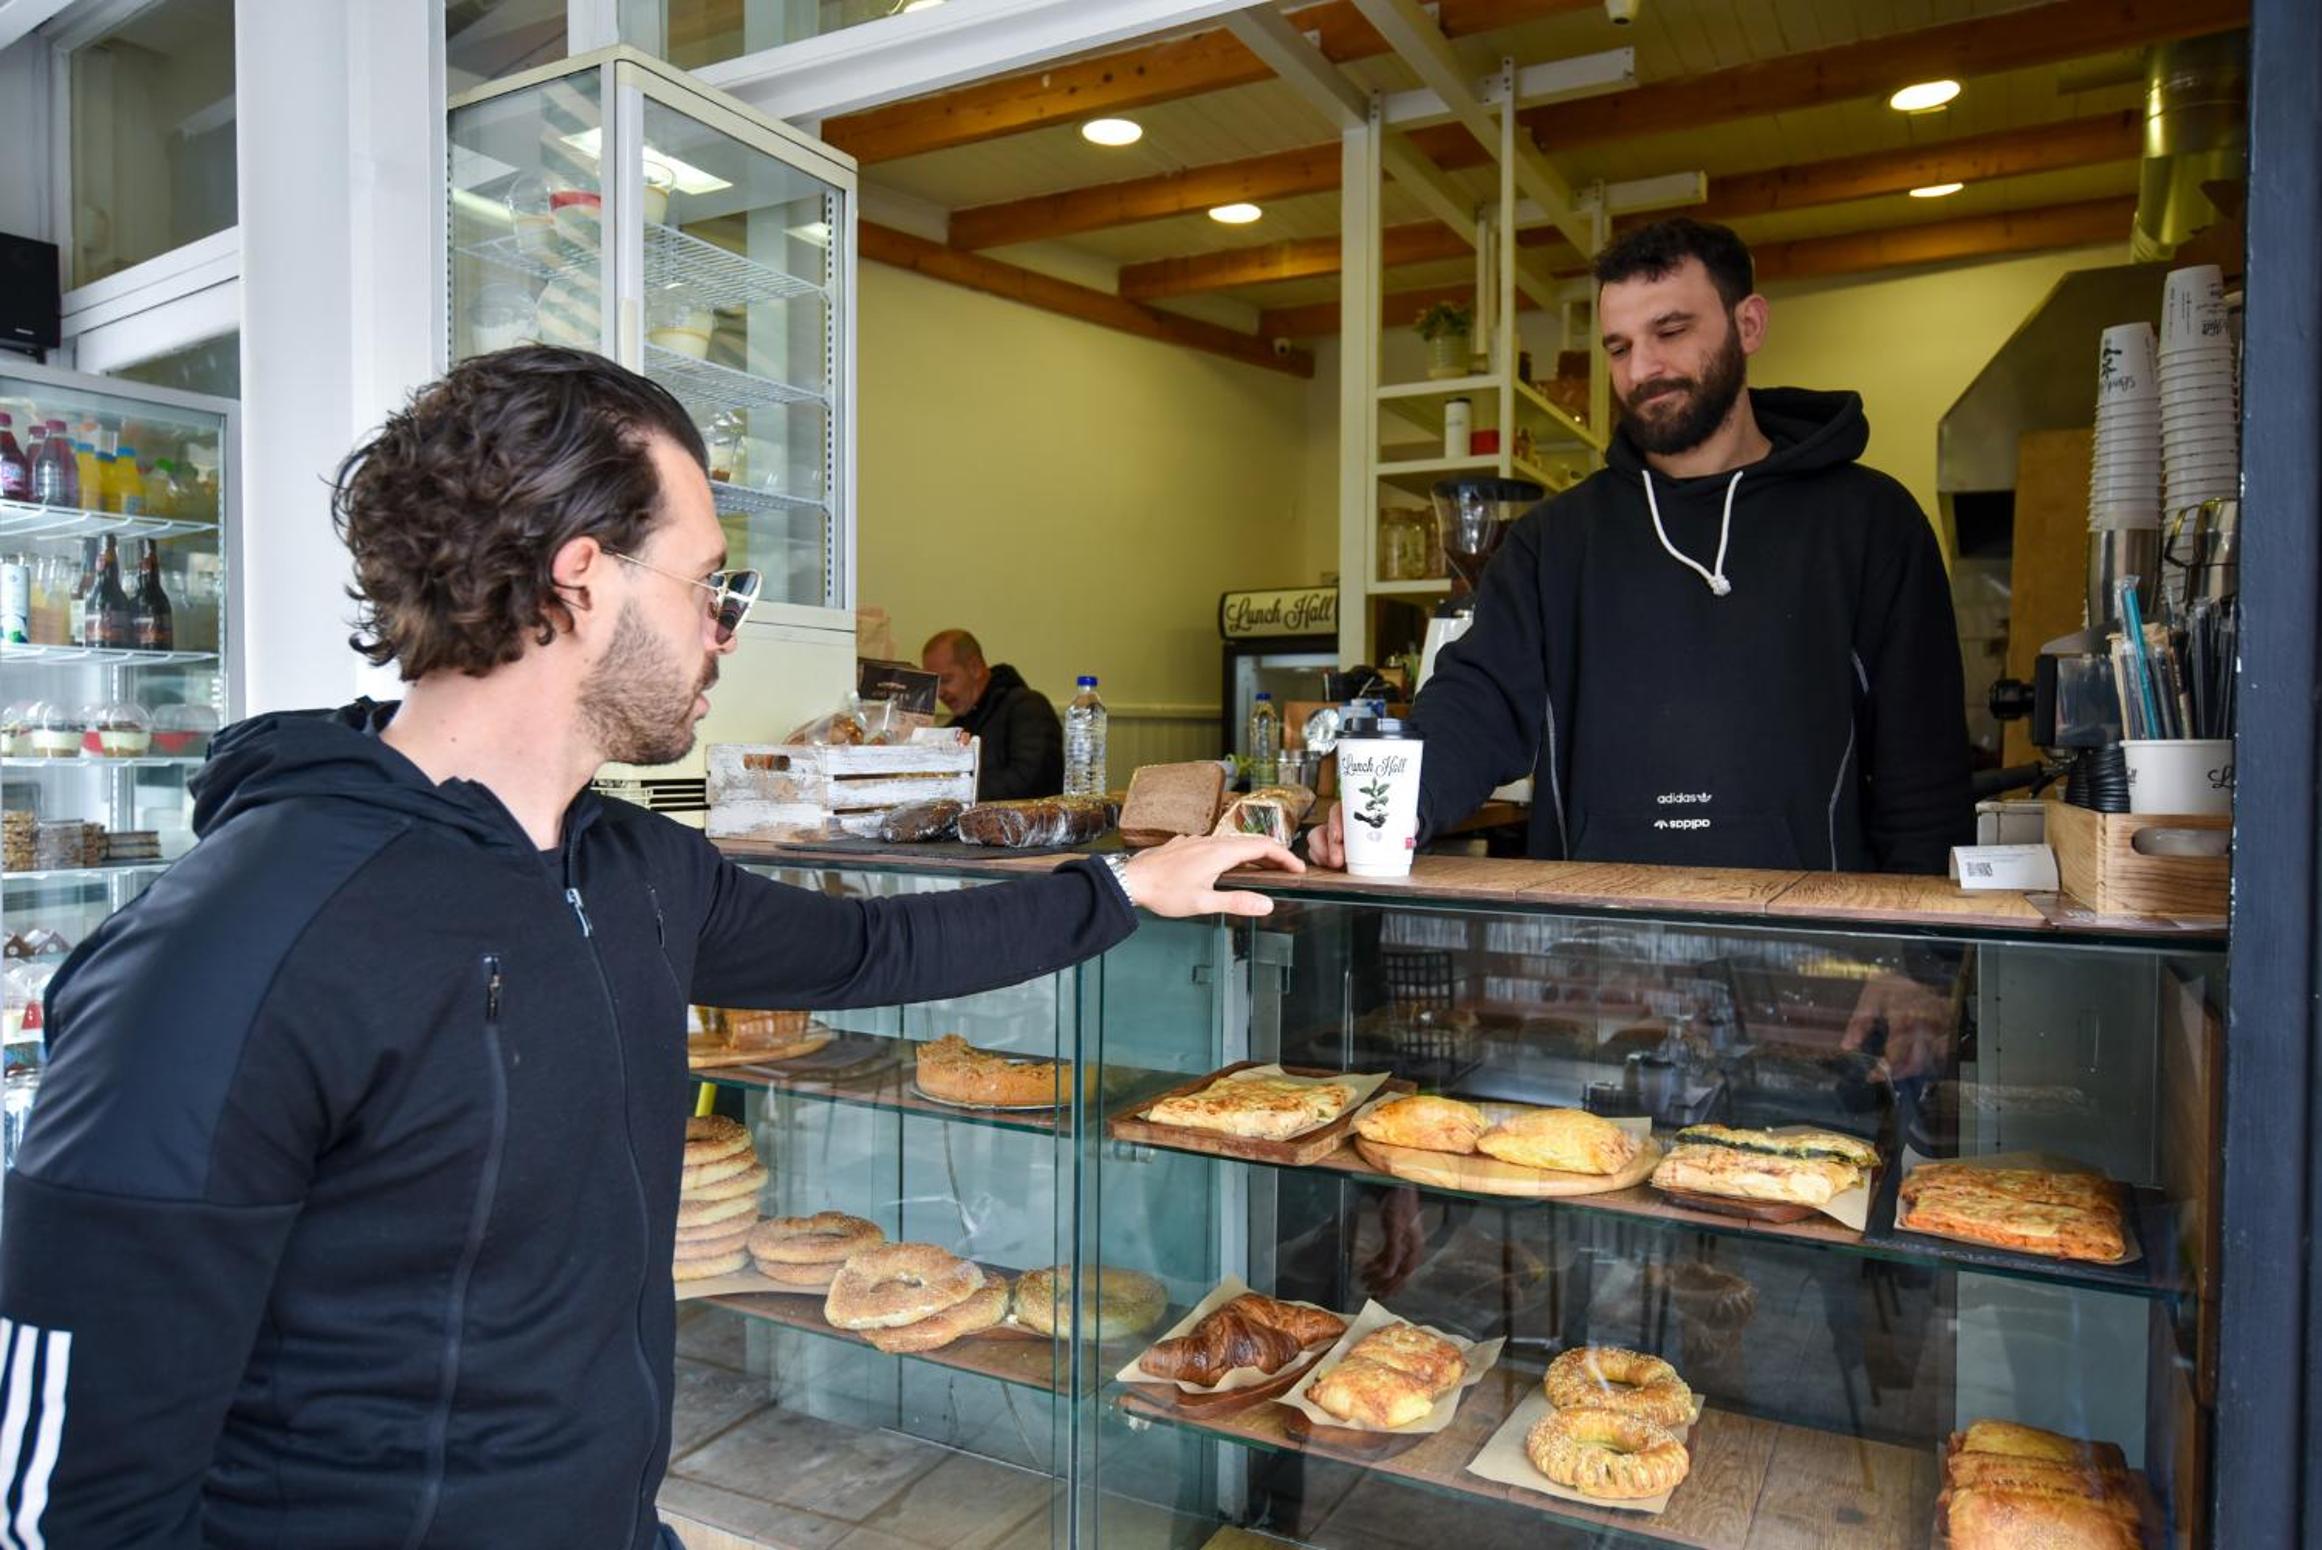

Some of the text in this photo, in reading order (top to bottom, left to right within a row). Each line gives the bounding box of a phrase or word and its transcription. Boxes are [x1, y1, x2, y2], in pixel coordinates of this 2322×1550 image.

[1226, 593, 1334, 632] Lunch Hall
[1341, 753, 1407, 777] Lunch Hall
[1657, 792, 1697, 804] adidas
